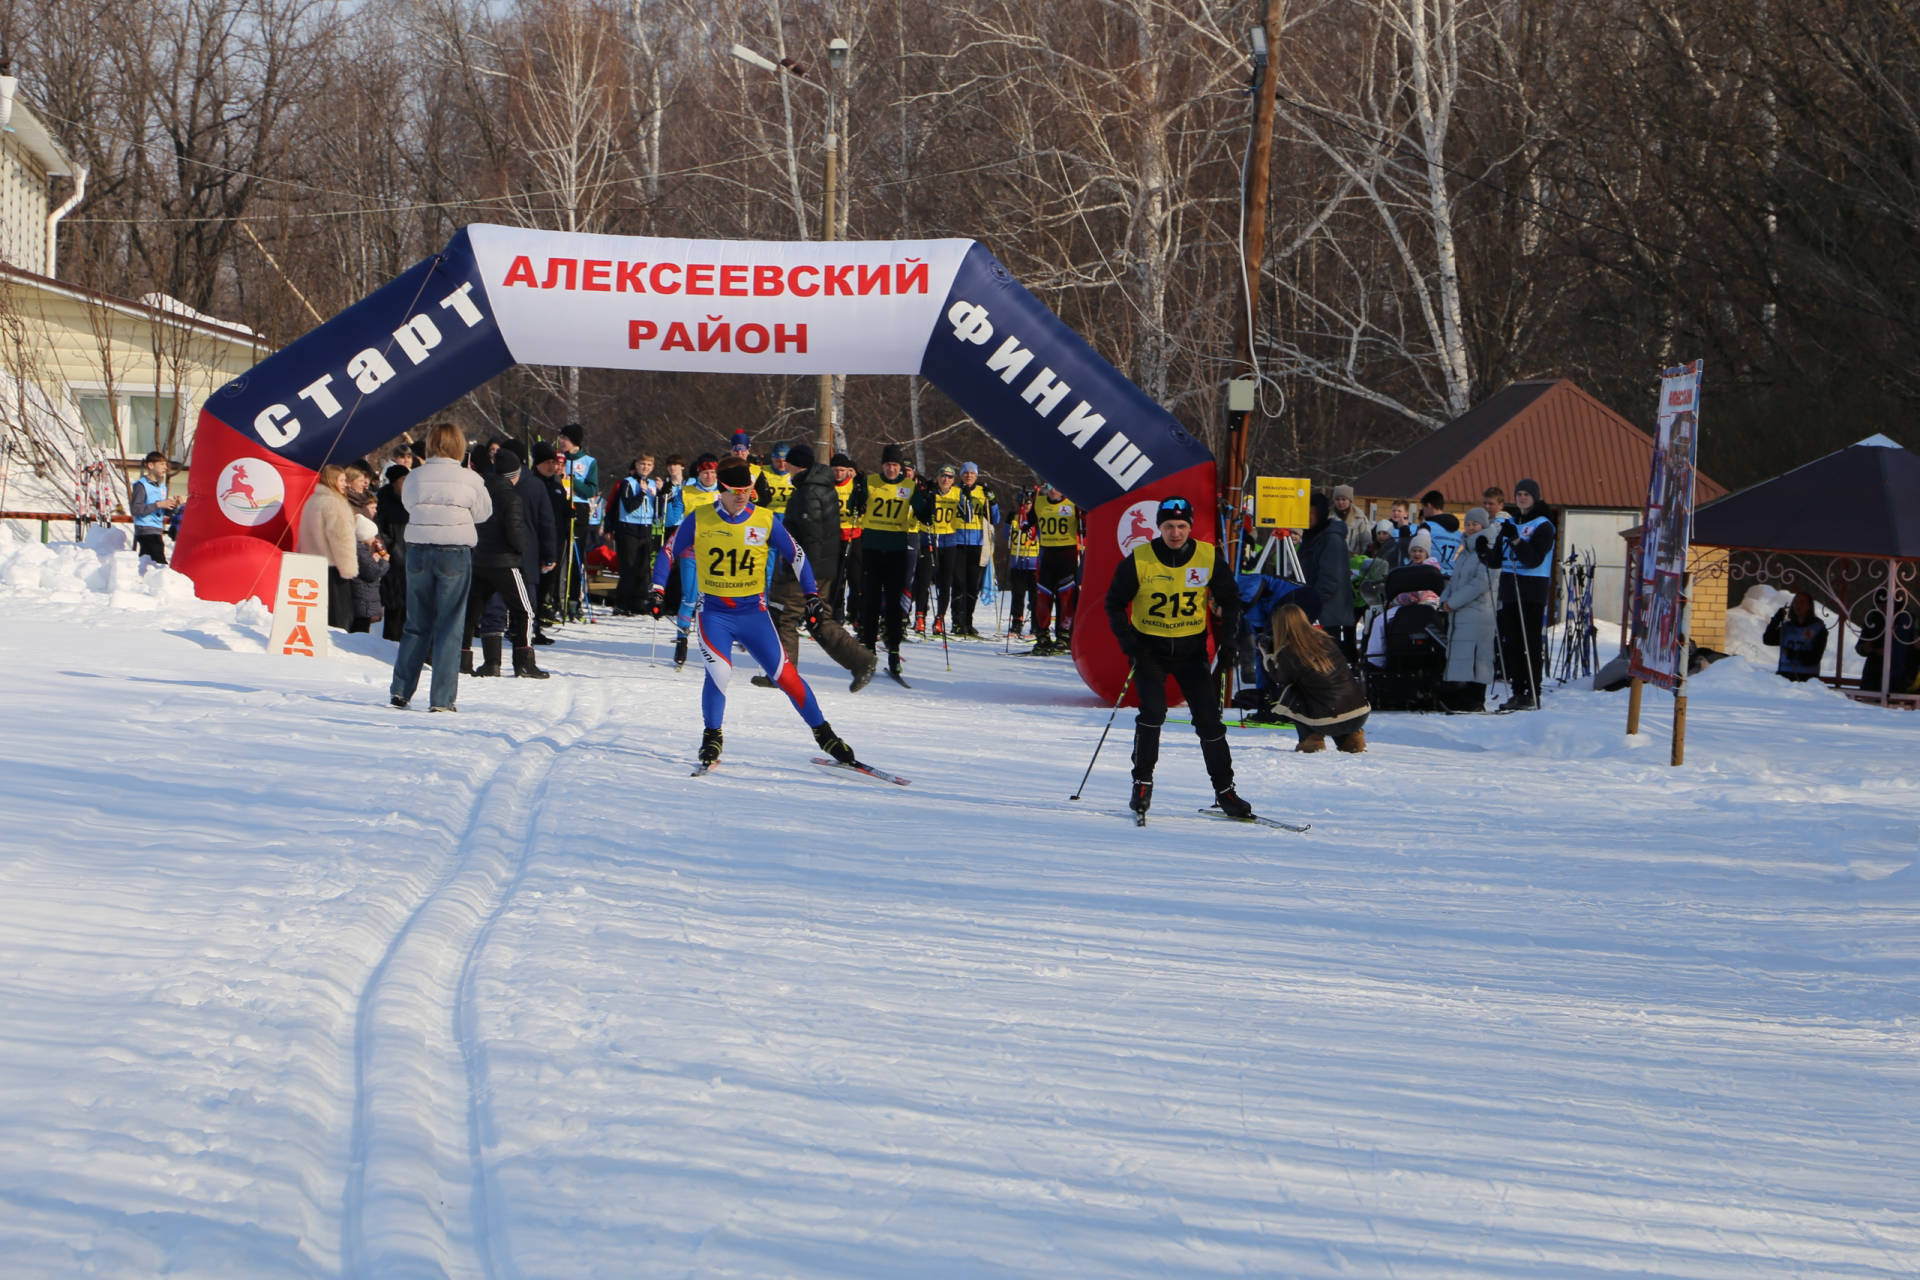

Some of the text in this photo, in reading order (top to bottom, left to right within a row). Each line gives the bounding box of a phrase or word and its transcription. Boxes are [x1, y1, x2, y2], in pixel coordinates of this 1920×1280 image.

[503, 256, 928, 297] АЛЕКСЕЕВСКИЙ
[630, 315, 807, 353] РАЙОН
[873, 497, 904, 519] 217
[1039, 517, 1069, 535] 206
[708, 547, 756, 577] 214
[1441, 545, 1456, 563] 17
[1149, 591, 1198, 618] 213
[1142, 619, 1185, 629] АЛЕКСЕЕВСКИЙ
